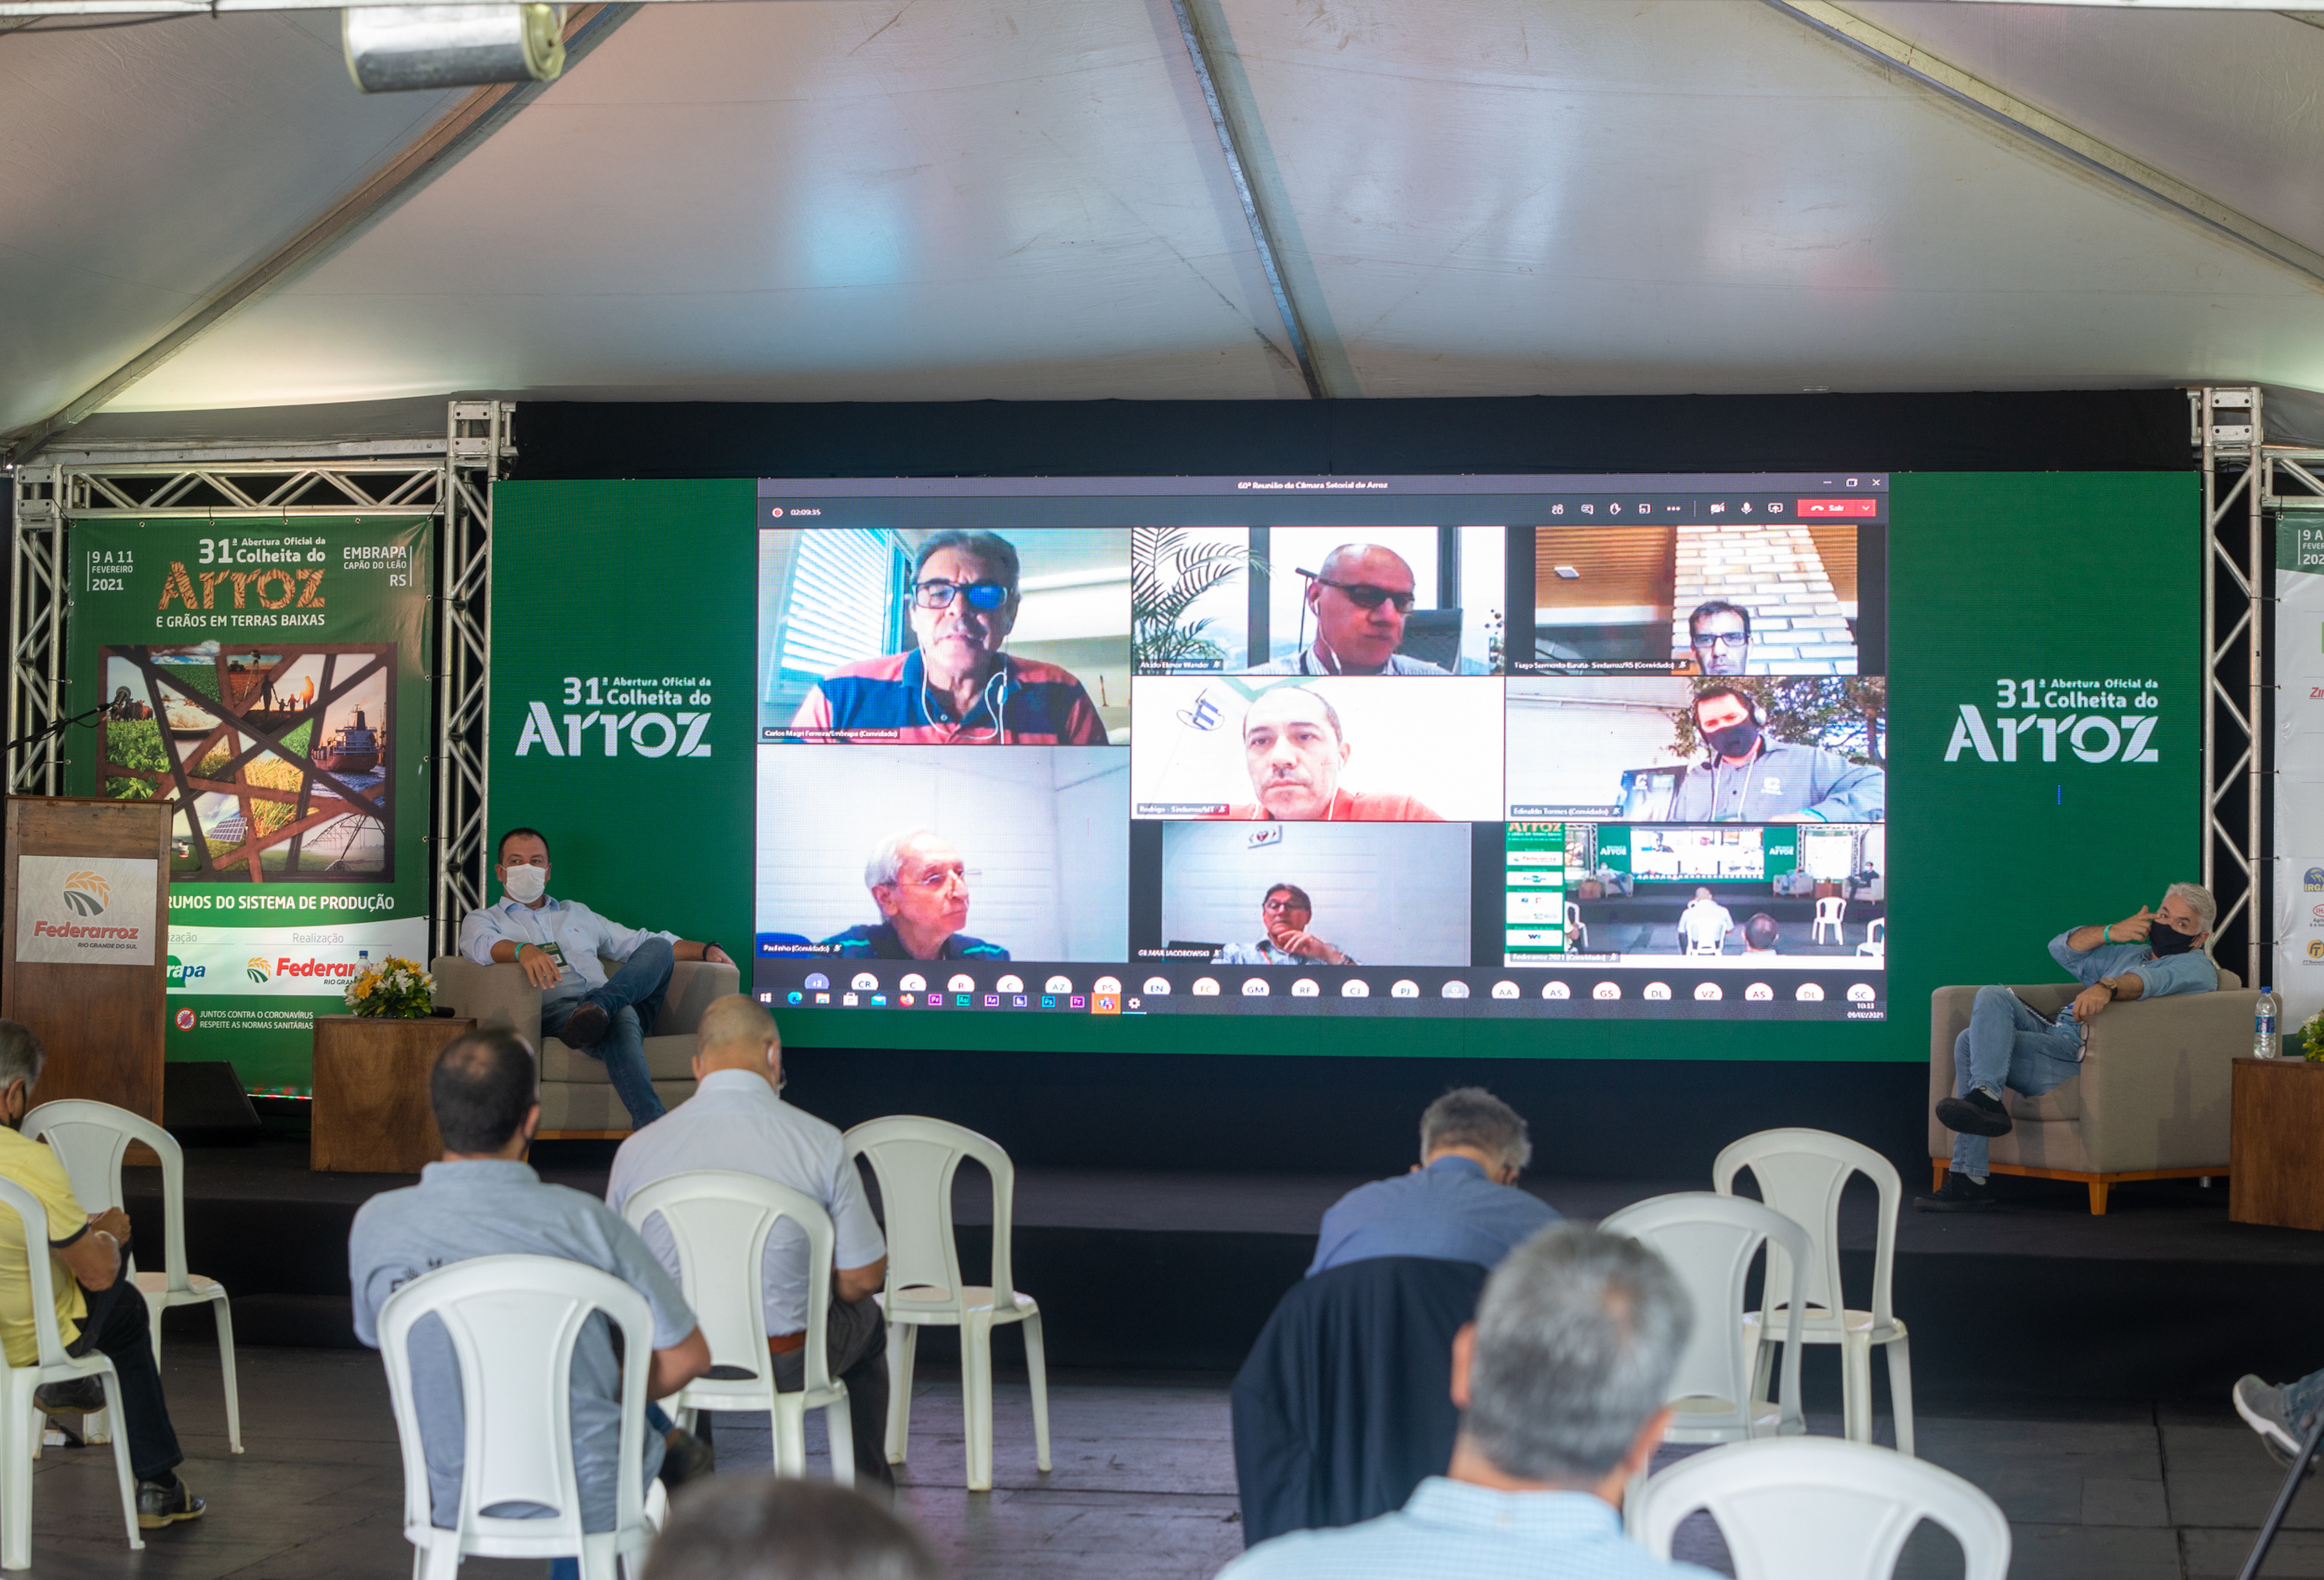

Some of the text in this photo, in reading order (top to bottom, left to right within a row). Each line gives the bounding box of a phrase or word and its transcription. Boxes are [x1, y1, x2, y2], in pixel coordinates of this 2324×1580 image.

[1296, 481, 1325, 489] Câmara
[1326, 481, 1353, 489] Setorial
[241, 537, 280, 546] Abertura
[284, 537, 312, 546] Oficial
[315, 536, 325, 546] da
[2303, 530, 2323, 540] 9 A
[92, 550, 133, 563] 9 A 11
[236, 547, 325, 563] Colheita do
[343, 546, 407, 560] EMBRAPA
[92, 565, 133, 573] FEVEREIRO
[343, 560, 370, 570] CAPÃO
[387, 560, 407, 569] LEÃO
[92, 578, 124, 591] 2021
[157, 561, 325, 610] Arroz
[390, 574, 406, 586] RS
[156, 612, 325, 627] E GRÃOS EM TERRAS BAIXAS
[614, 678, 658, 686] Abertura
[662, 678, 696, 686] Oficial
[699, 678, 711, 686] da
[2051, 678, 2100, 689] Abertura
[2105, 678, 2141, 688] Oficial
[2145, 678, 2159, 688] da
[607, 689, 711, 705] Colheita do
[2044, 691, 2159, 708] Colheita do
[515, 701, 712, 758] Arroz
[1944, 704, 2159, 763] Arroz
[216, 896, 234, 909] DO
[239, 896, 296, 910] SISTEMA
[298, 896, 316, 910] DE
[321, 893, 394, 913] PRODUÇÃO
[33, 920, 139, 940] Federarroz
[167, 932, 197, 944] ização
[293, 932, 344, 945] Realização
[167, 966, 205, 981] rapa
[276, 957, 355, 977] Federar
[200, 1010, 313, 1020] JUNTOS CONTRA O CORONAVÍRUS
[200, 1020, 231, 1029] RESPEITE
[273, 1020, 313, 1030] SANITÁRIAS
